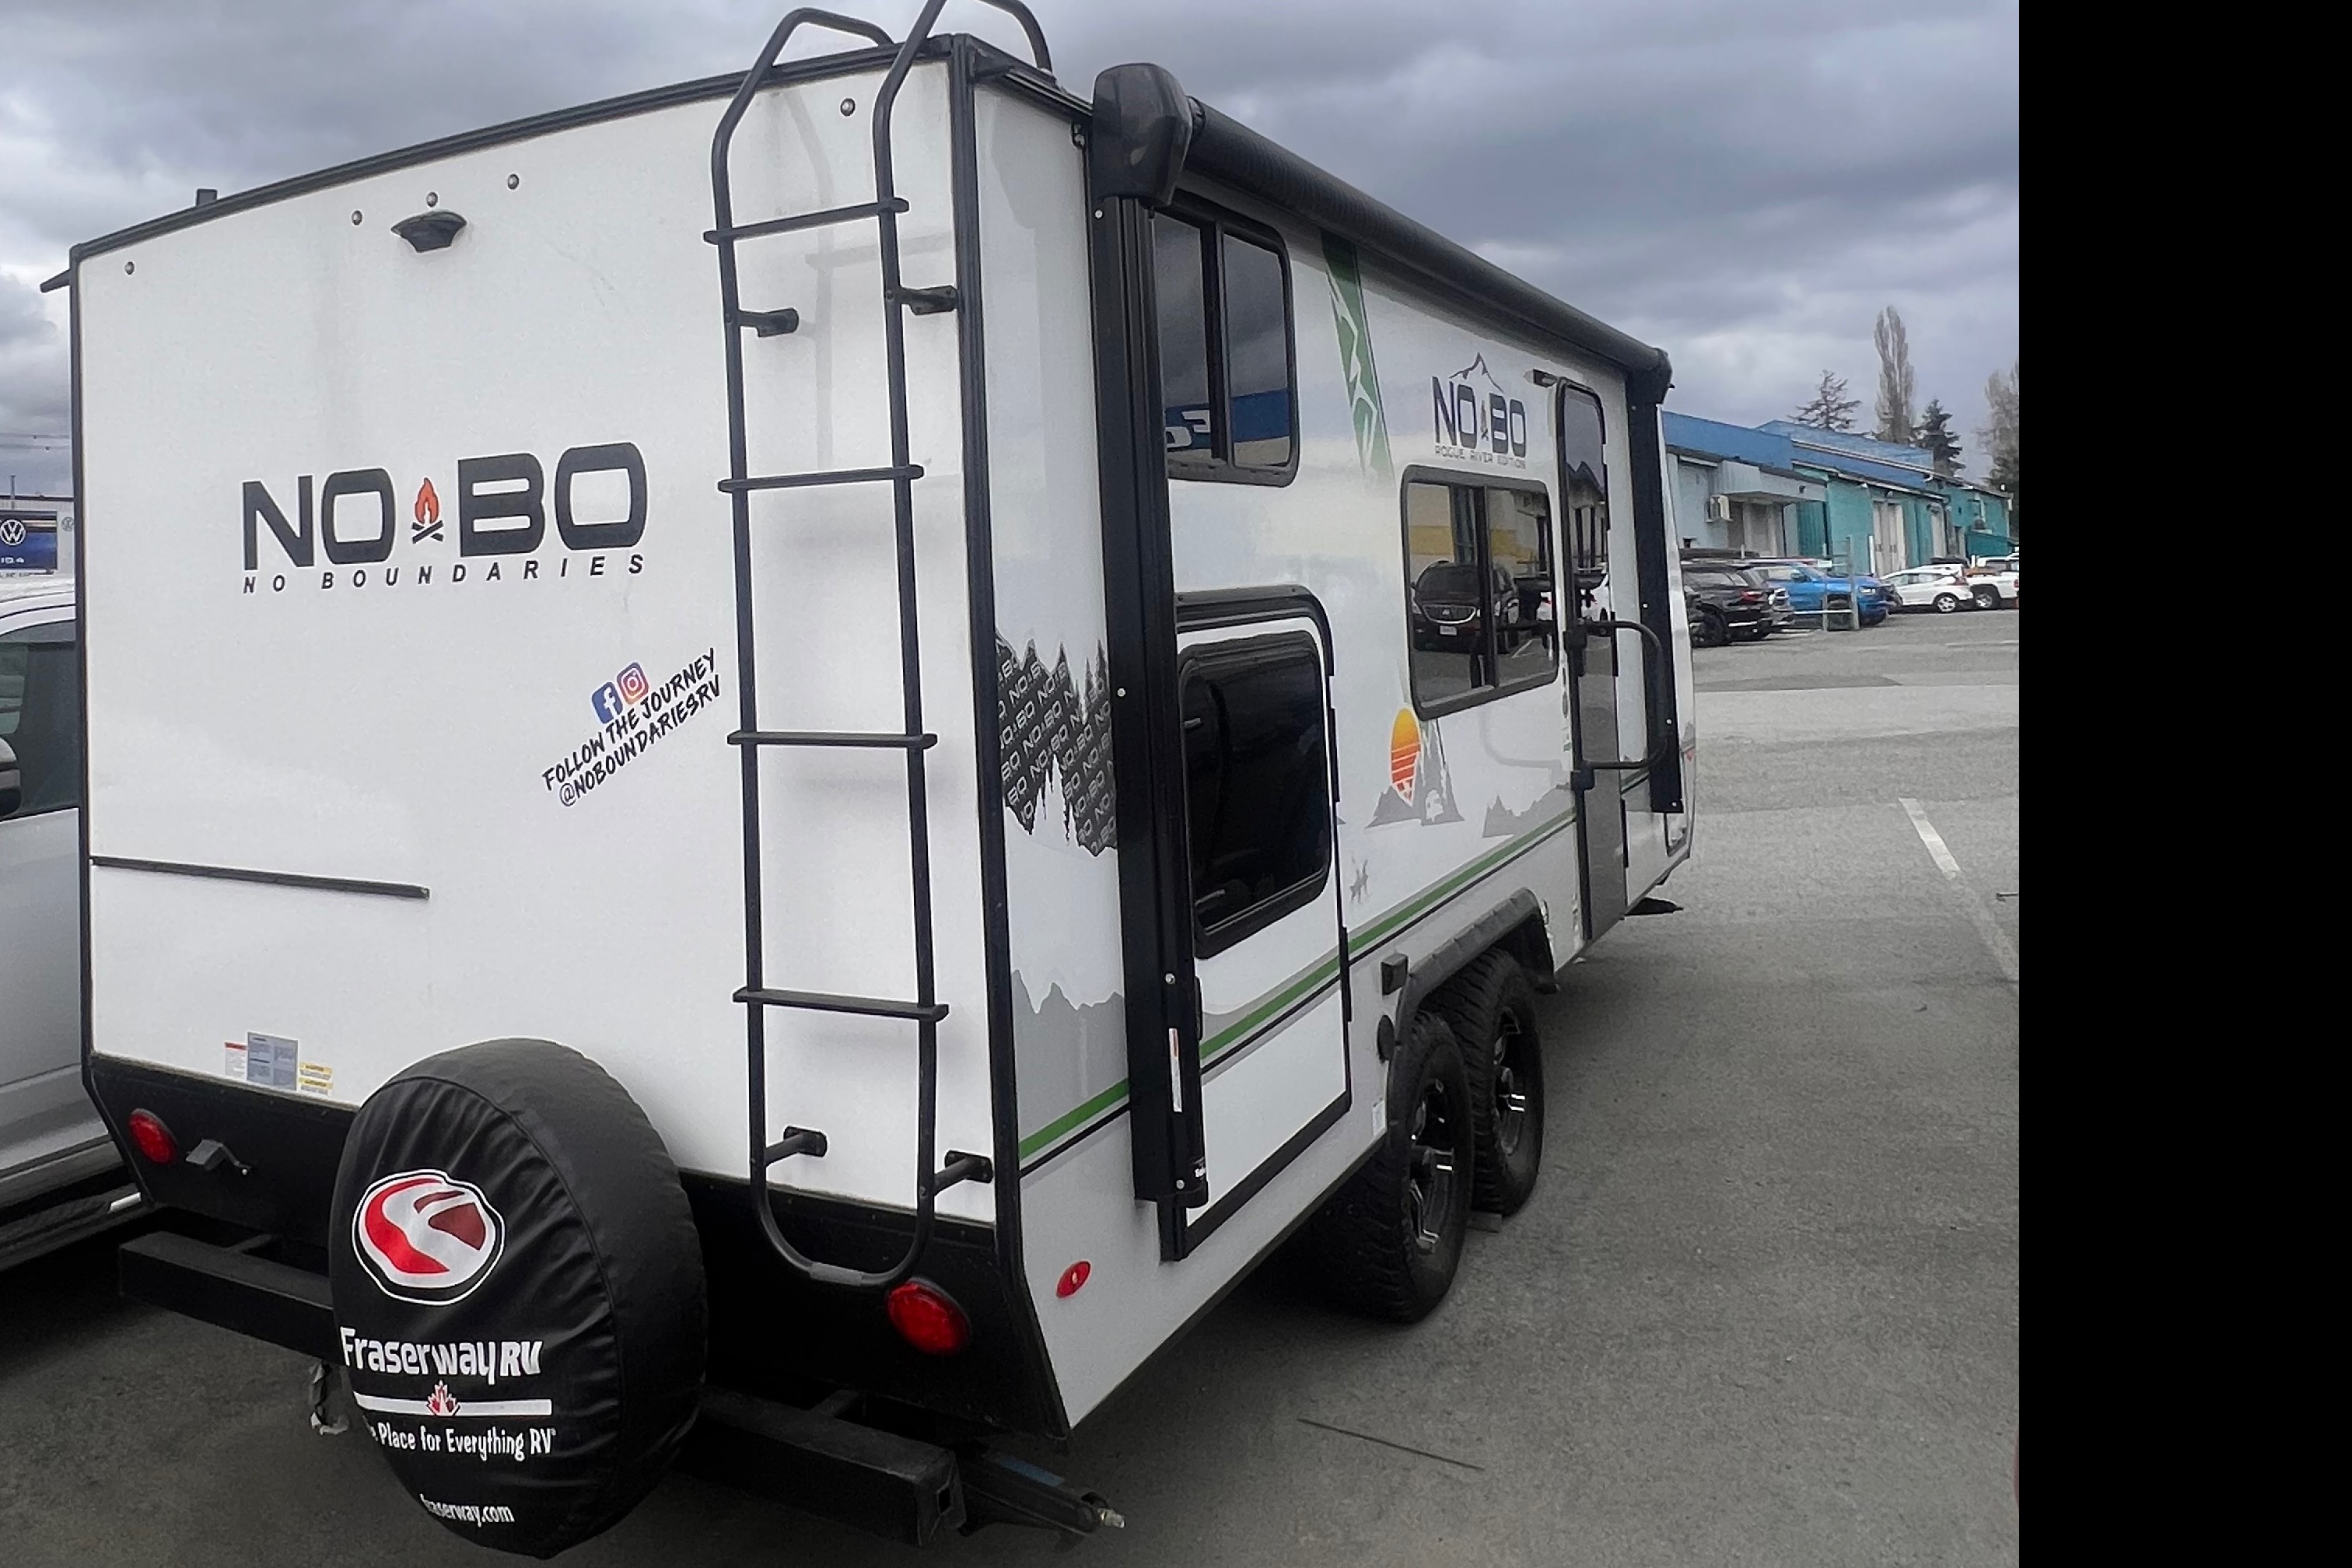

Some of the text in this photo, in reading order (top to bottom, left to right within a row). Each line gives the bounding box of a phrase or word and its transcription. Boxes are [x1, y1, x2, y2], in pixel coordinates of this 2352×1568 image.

[243, 442, 647, 571] NO BO
[243, 554, 644, 594] NO BOUNDARIES
[541, 646, 715, 792] FOLLOW THE JOURNEY
[558, 673, 721, 807] @NOBOUNDARIESRV
[339, 1325, 496, 1386] Fraserway
[377, 1421, 417, 1451] Place
[420, 1424, 442, 1452] for
[445, 1426, 526, 1462] Everything
